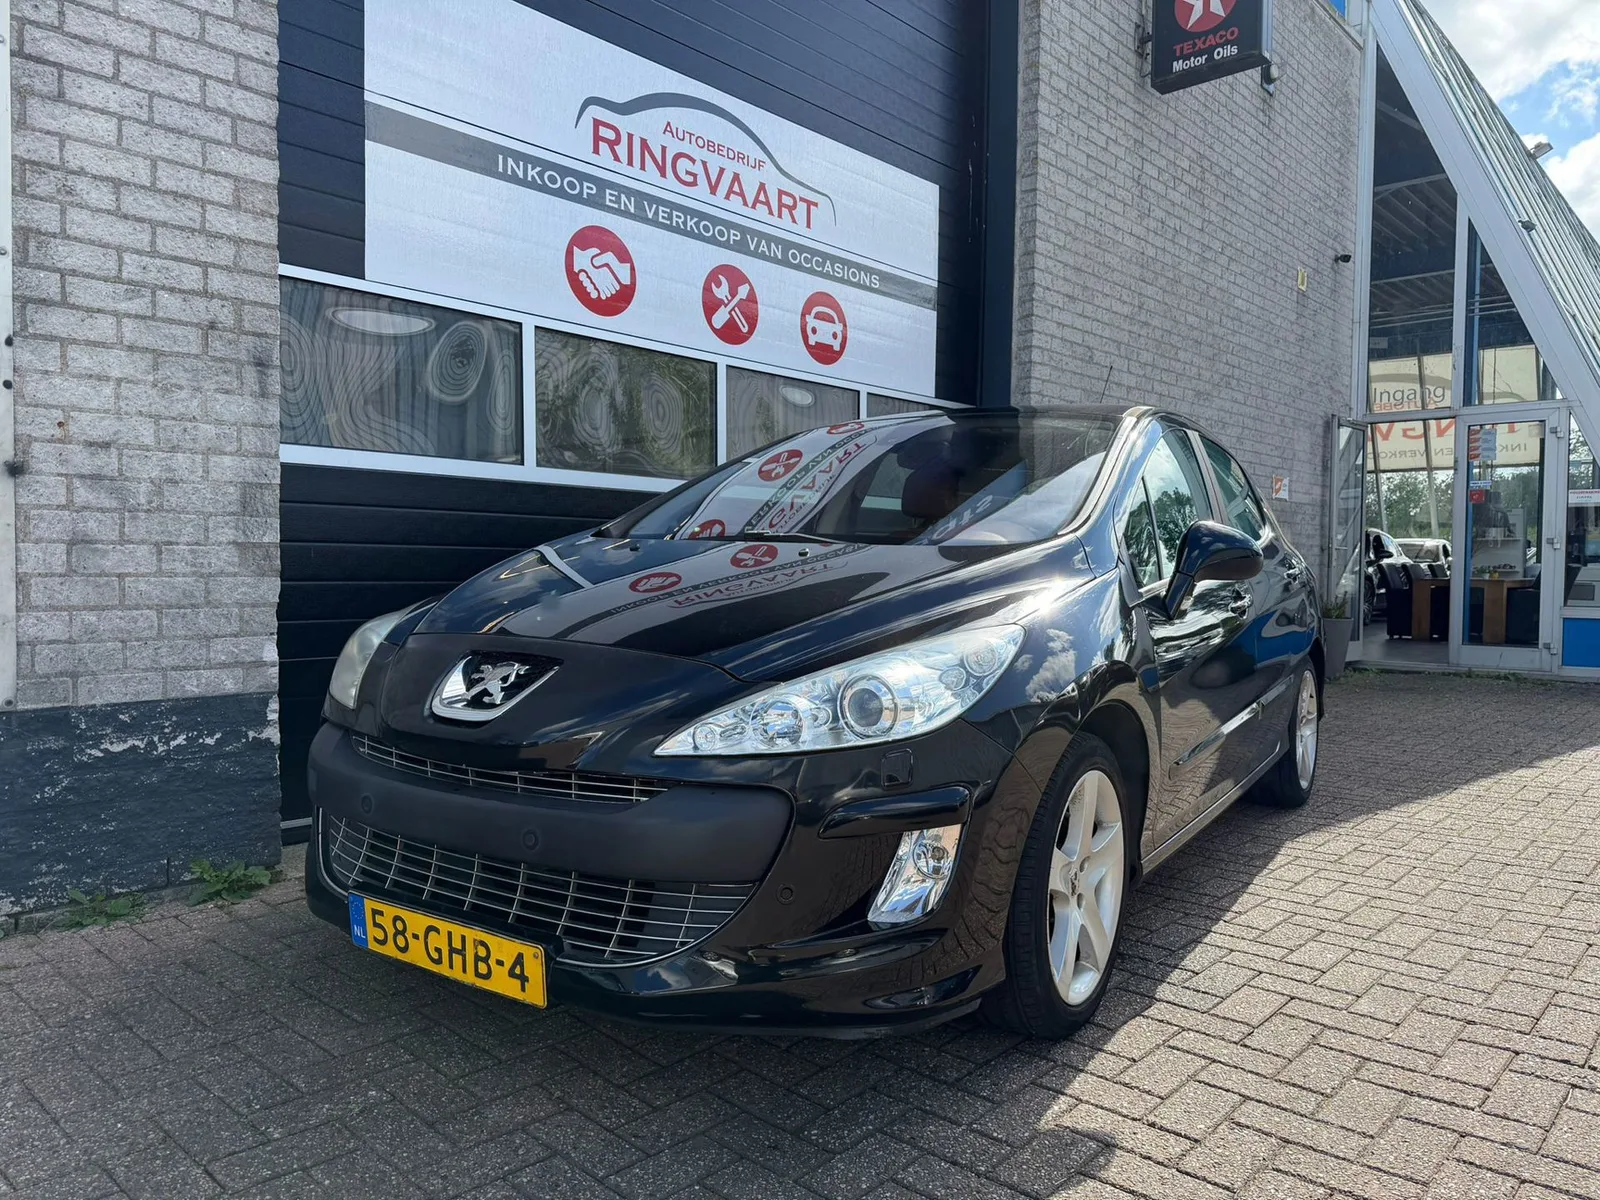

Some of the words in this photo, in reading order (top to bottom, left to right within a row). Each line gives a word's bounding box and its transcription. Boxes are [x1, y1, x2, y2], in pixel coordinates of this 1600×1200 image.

[1172, 54, 1208, 73] Motor
[1213, 44, 1238, 60] Oils
[1173, 27, 1239, 57] TEXACO
[663, 121, 767, 172] AUTOBEDRIJF
[591, 117, 819, 229] RINGVAART
[498, 154, 597, 199] INKOOP
[605, 188, 636, 214] EN
[643, 201, 741, 244] VERKOOP
[746, 234, 782, 260] VAN
[788, 249, 880, 288] OCCASIONS
[1373, 386, 1446, 407] Ingang
[353, 927, 366, 939] NL
[371, 907, 530, 993] 58-GHB-4
